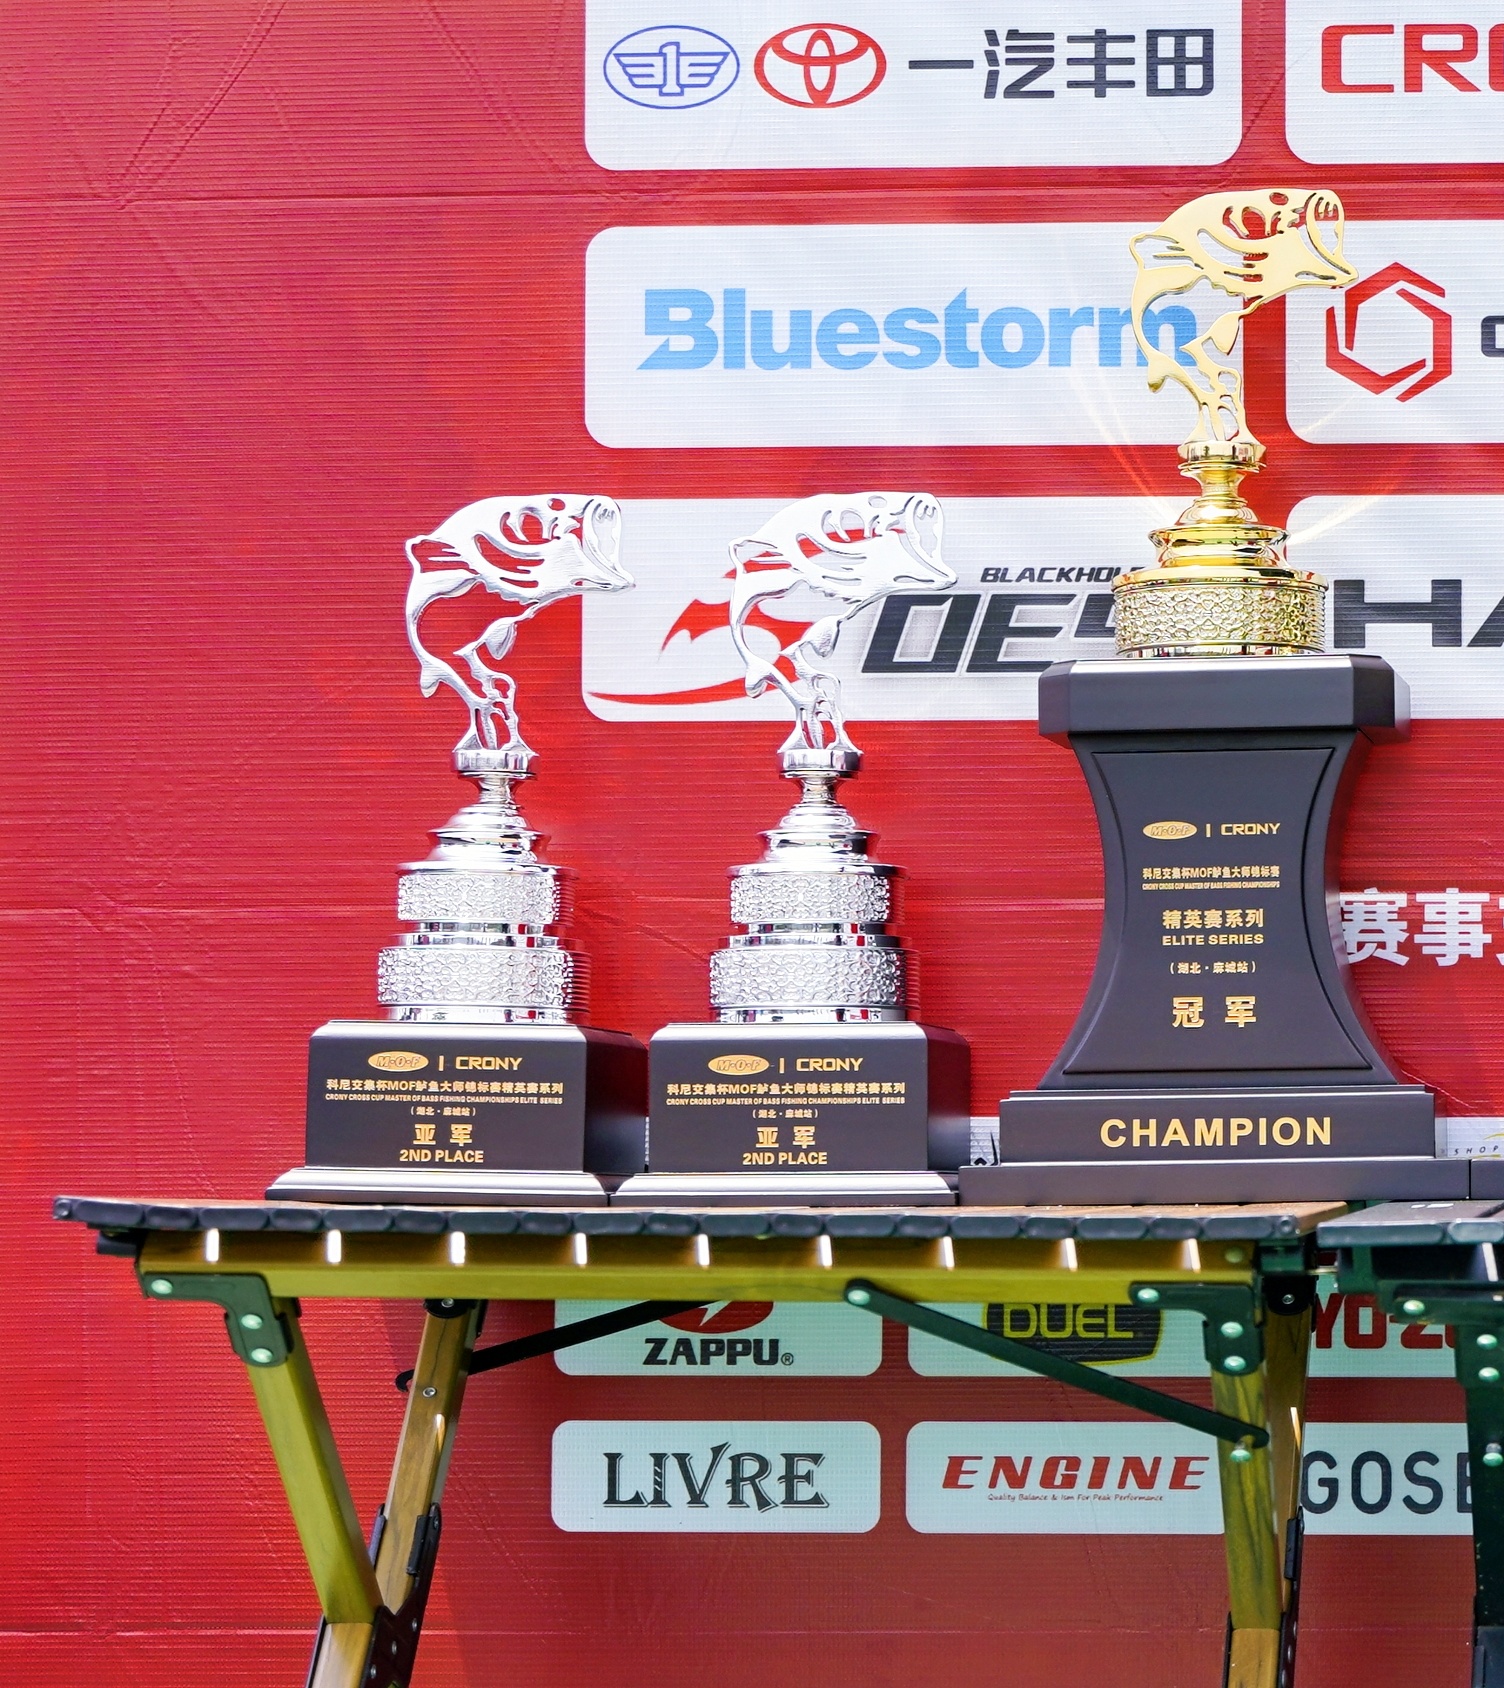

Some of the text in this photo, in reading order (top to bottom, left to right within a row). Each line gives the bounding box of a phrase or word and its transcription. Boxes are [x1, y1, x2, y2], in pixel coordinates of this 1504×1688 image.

[908, 28, 1215, 99] 一汽丰田
[636, 286, 1197, 370] Bluestorm
[1221, 823, 1280, 835] CRONY
[1162, 909, 1264, 929] 精英赛系列
[1162, 934, 1264, 946] ELITE SERIES
[455, 1056, 523, 1070] CRONY
[796, 1058, 863, 1072] CRONY
[1100, 1117, 1331, 1148] CHAMPION
[400, 1150, 484, 1163] 2ND PLACE
[742, 1152, 827, 1165] 2ND PLACE
[1003, 1303, 1133, 1339] DUEL
[643, 1338, 779, 1366] ZAPPU
[602, 1442, 830, 1512] LIVRE
[941, 1455, 1210, 1490] ENGINE
[988, 1493, 1015, 1502] Quality
[1019, 1493, 1048, 1501] Balance
[1078, 1493, 1090, 1501] For
[1093, 1493, 1111, 1501] Peak
[1114, 1493, 1163, 1501] Performance
